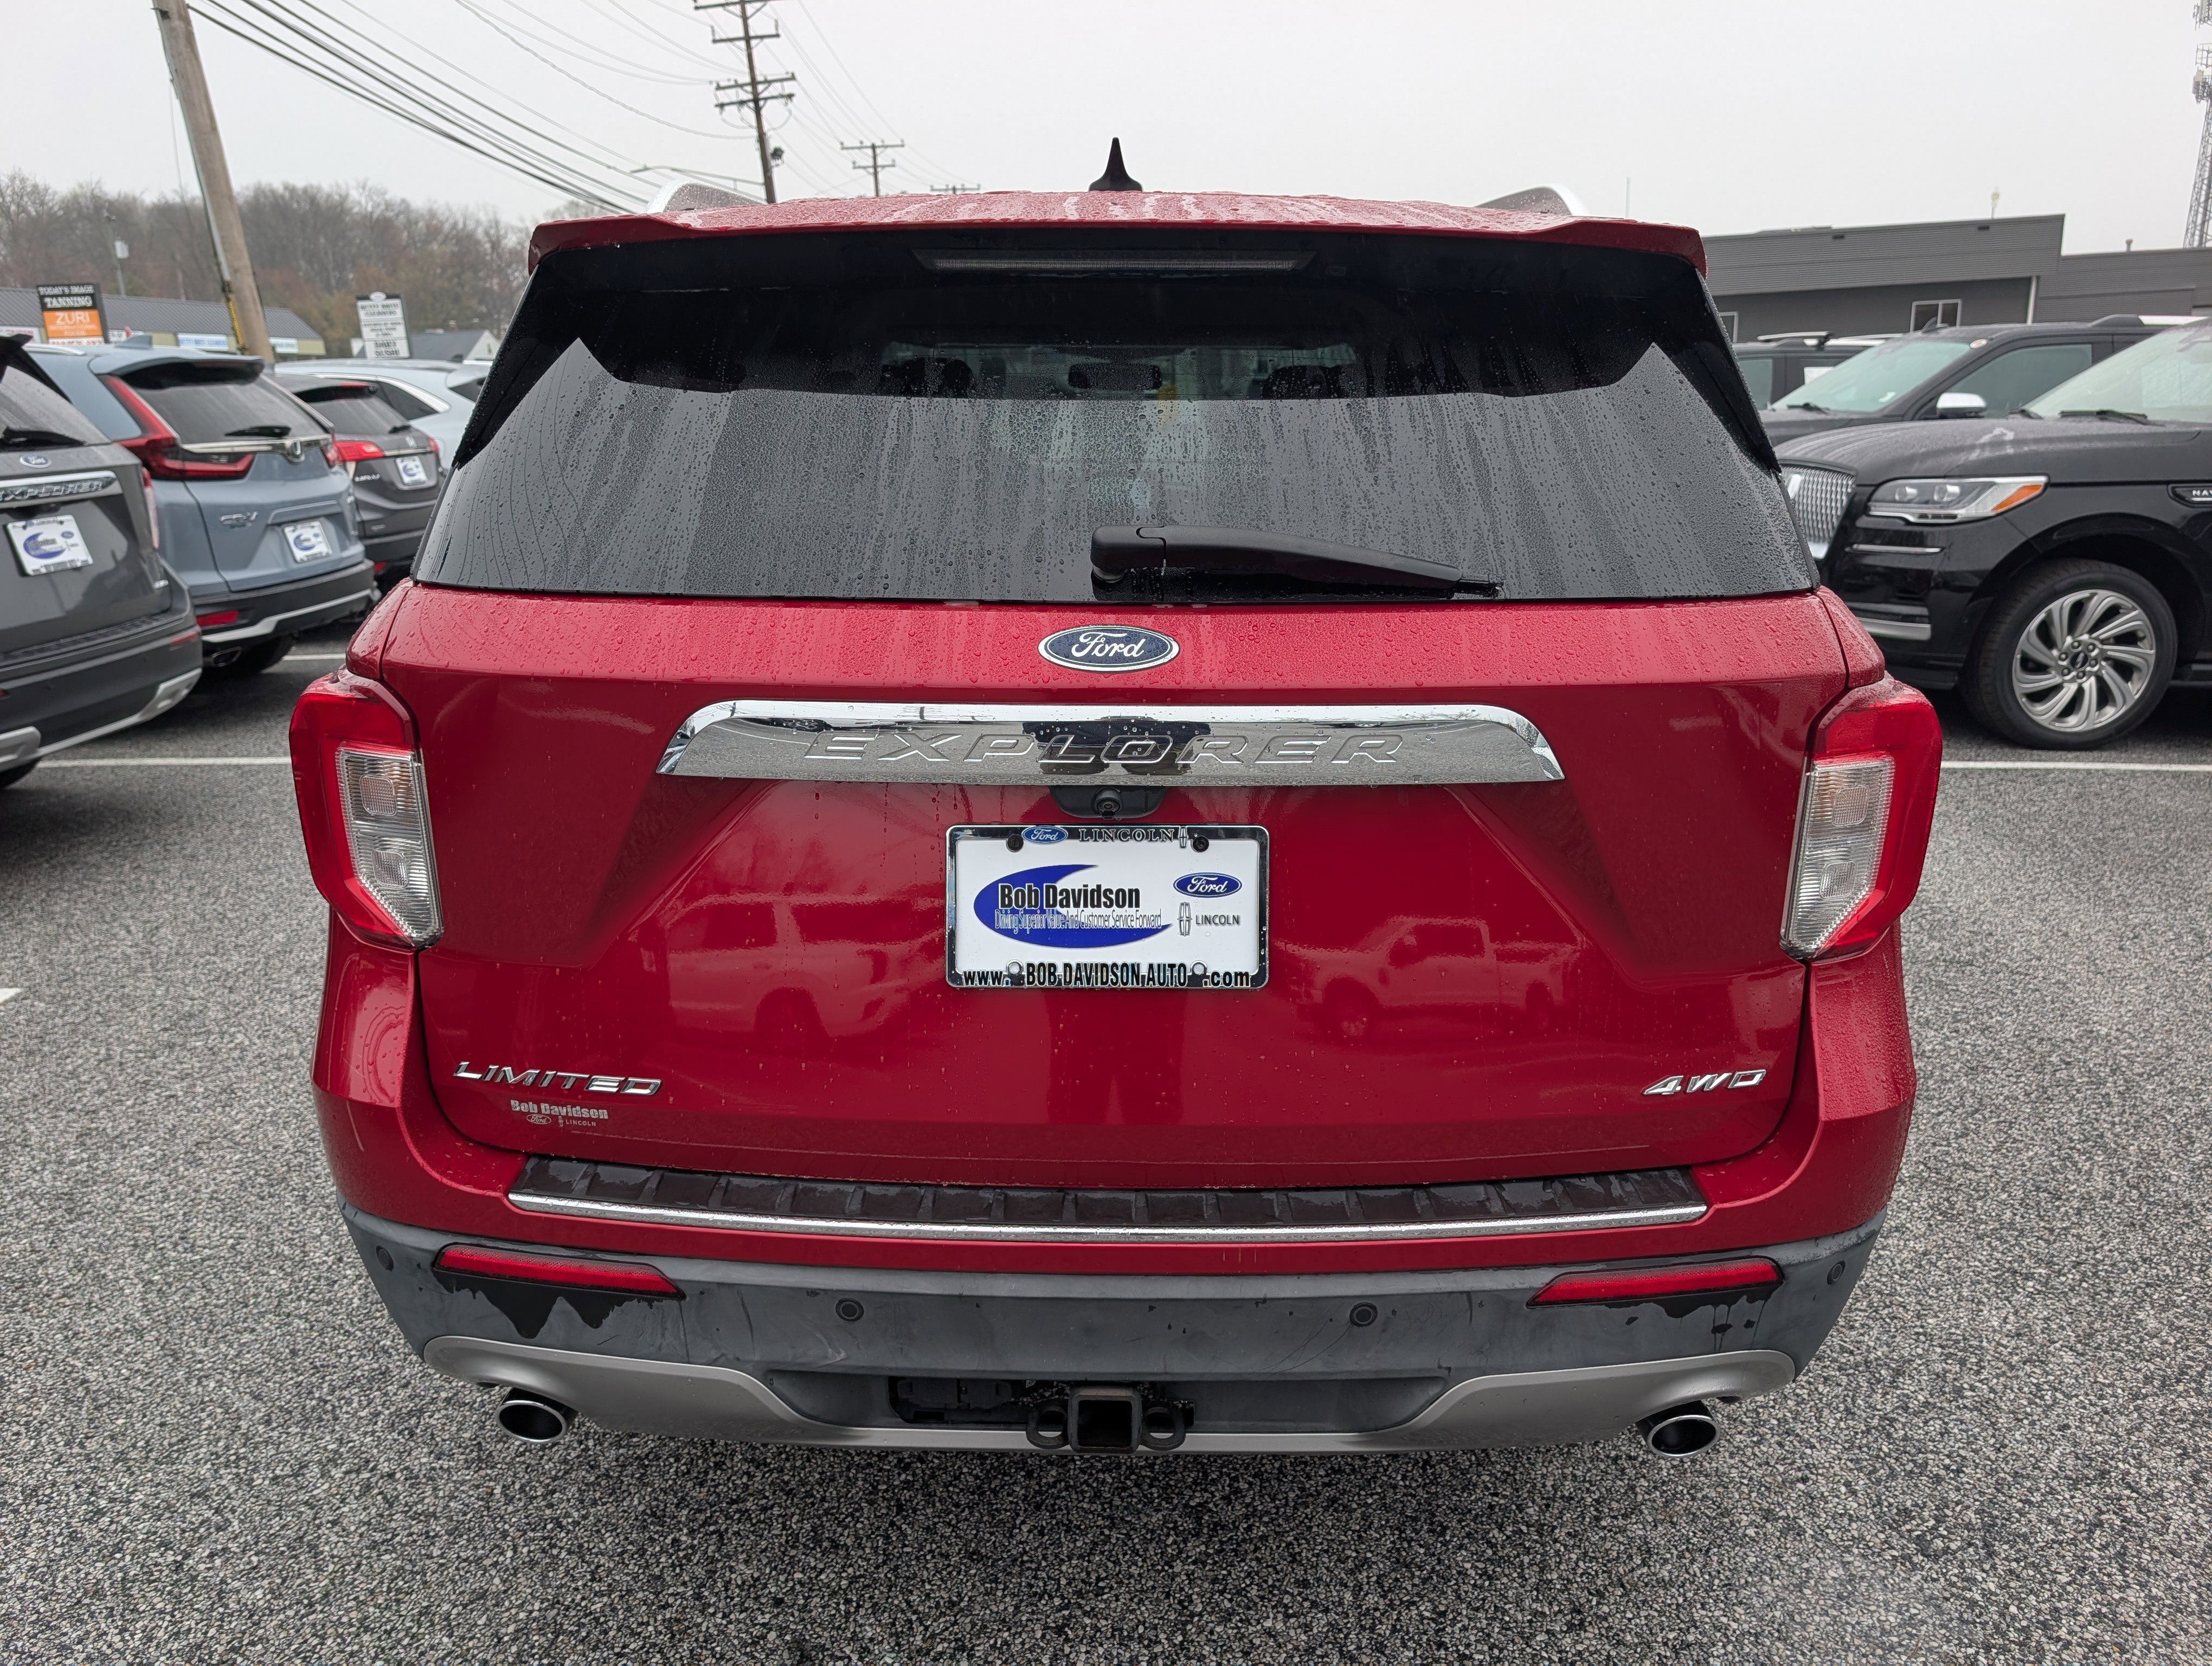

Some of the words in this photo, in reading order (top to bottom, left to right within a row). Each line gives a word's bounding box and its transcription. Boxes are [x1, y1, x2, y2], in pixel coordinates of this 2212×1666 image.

[44, 296, 93, 308] TANNING
[55, 311, 91, 325] ZURI
[1071, 632, 1146, 657] Ford
[805, 730, 1405, 766] EXPLORER
[1031, 828, 1059, 841] Ford
[1079, 828, 1174, 842] LINCOLN
[999, 883, 1040, 909] Bob
[1044, 883, 1140, 909] Davidson
[1187, 876, 1227, 893] Ford
[995, 909, 1018, 934] Driving
[1019, 909, 1046, 934] Superior
[1046, 909, 1065, 928] Value
[1065, 909, 1079, 928] And
[1079, 909, 1111, 928] Customer
[1111, 909, 1135, 928] Service
[1135, 908, 1162, 928] Forward
[1195, 914, 1241, 925] LINCOLN
[1026, 962, 1058, 987] BOB
[1064, 962, 1141, 987] DAVIDSON
[1146, 962, 1188, 987] AUTO
[453, 1061, 663, 1095] LIMITED
[1642, 1069, 1767, 1095] 4WD
[511, 1099, 537, 1113] Bob
[541, 1102, 609, 1120] Davidson
[530, 1115, 548, 1125] Ford
[565, 1119, 596, 1127] LINCOLN
